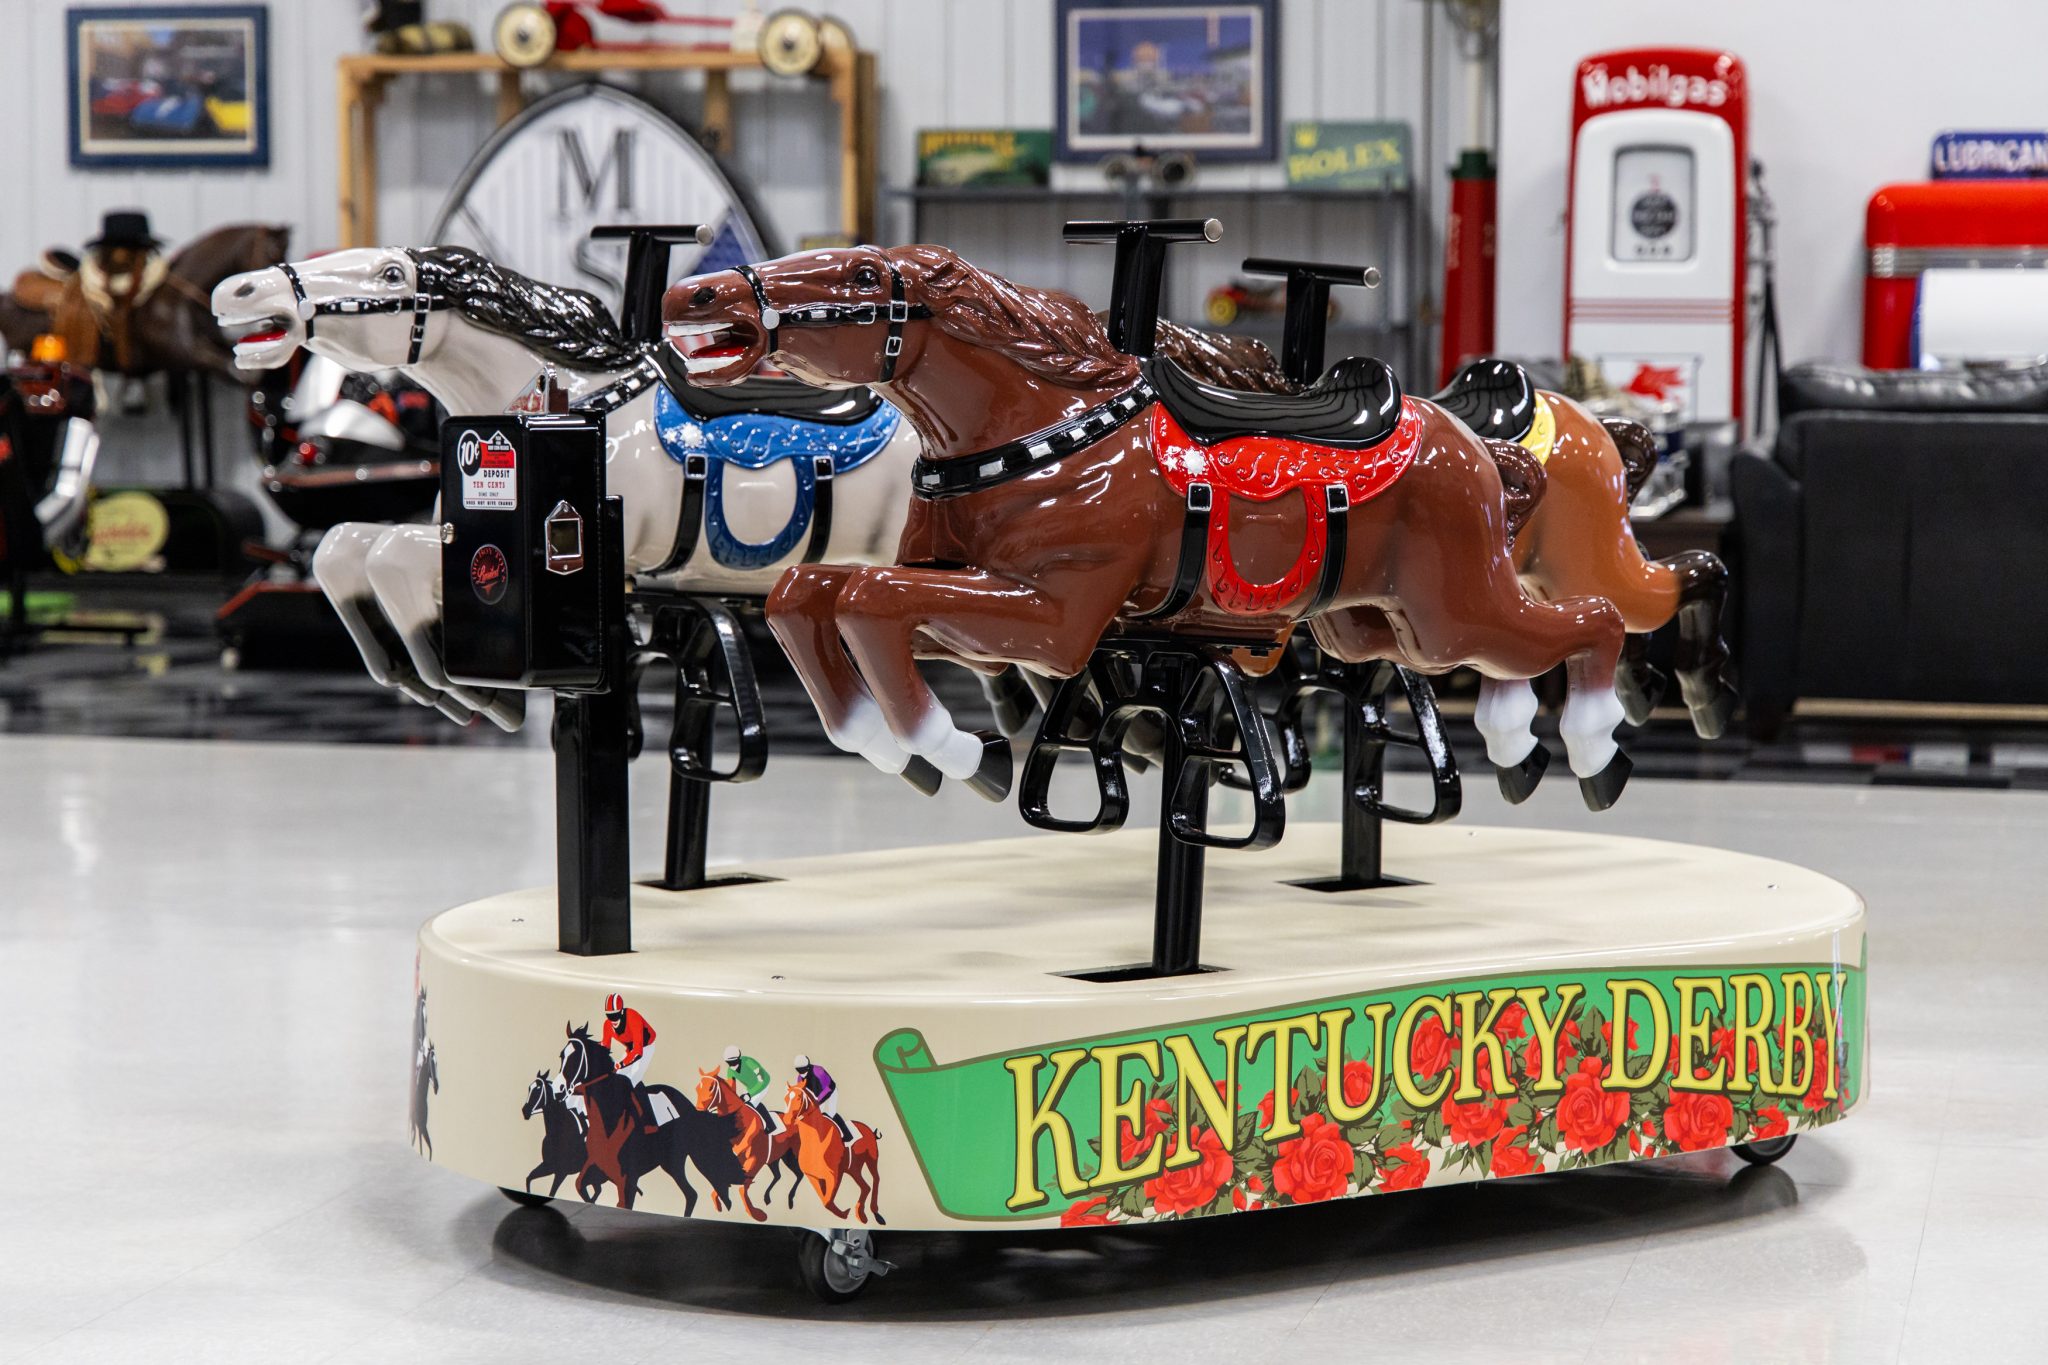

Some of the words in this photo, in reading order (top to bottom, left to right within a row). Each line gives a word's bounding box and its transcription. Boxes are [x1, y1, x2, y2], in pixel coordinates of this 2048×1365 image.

[1581, 63, 1729, 108] Mobilgas
[1288, 138, 1402, 182] ROLEX
[461, 440, 480, 467] 10¢
[484, 470, 510, 478] DEPOSIT
[1005, 982, 1585, 1213] KENTUCKY
[1600, 970, 1848, 1102] DERBY
